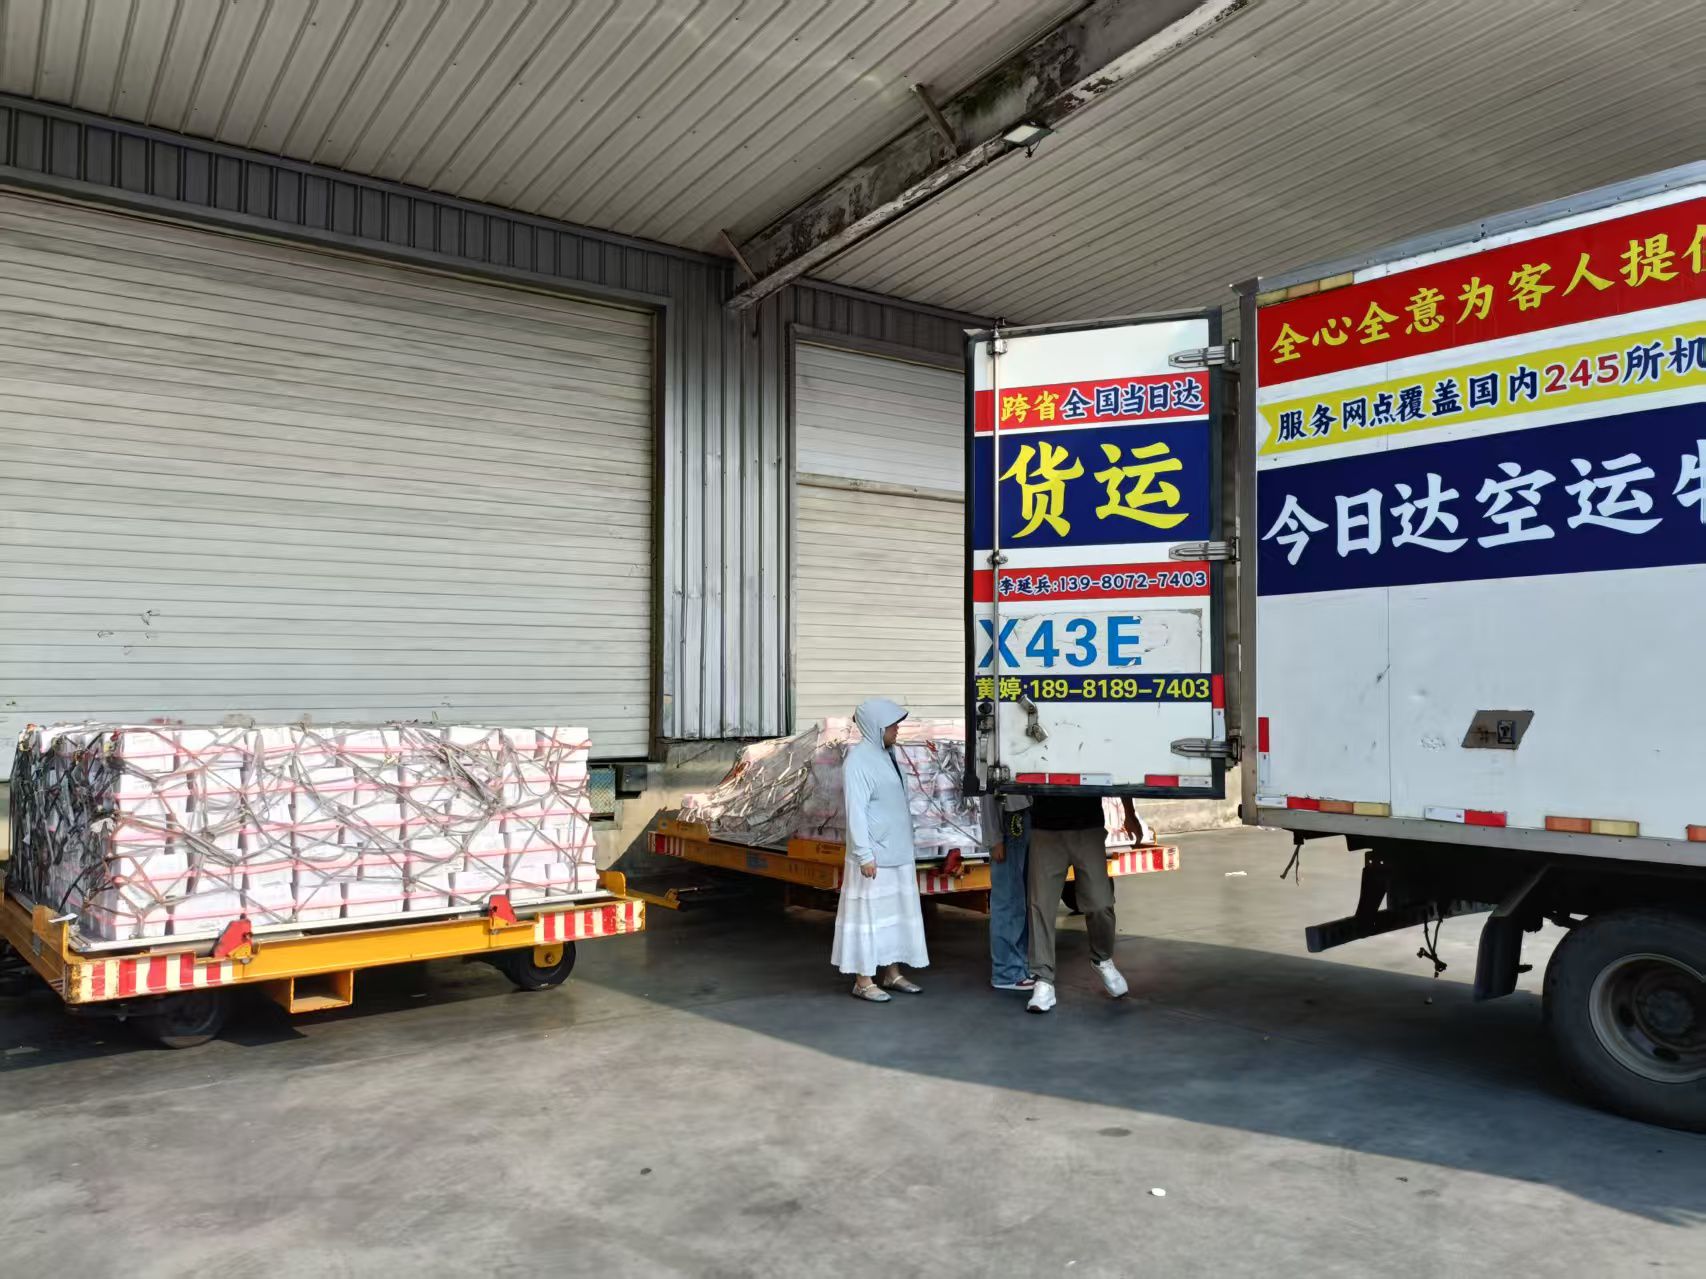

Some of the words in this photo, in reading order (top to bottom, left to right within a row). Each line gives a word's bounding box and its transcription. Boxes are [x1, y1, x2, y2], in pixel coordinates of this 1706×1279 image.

[1001, 378, 1205, 423] 跨省全国当日达
[999, 441, 1189, 538] 货运
[978, 616, 1142, 668] X43E
